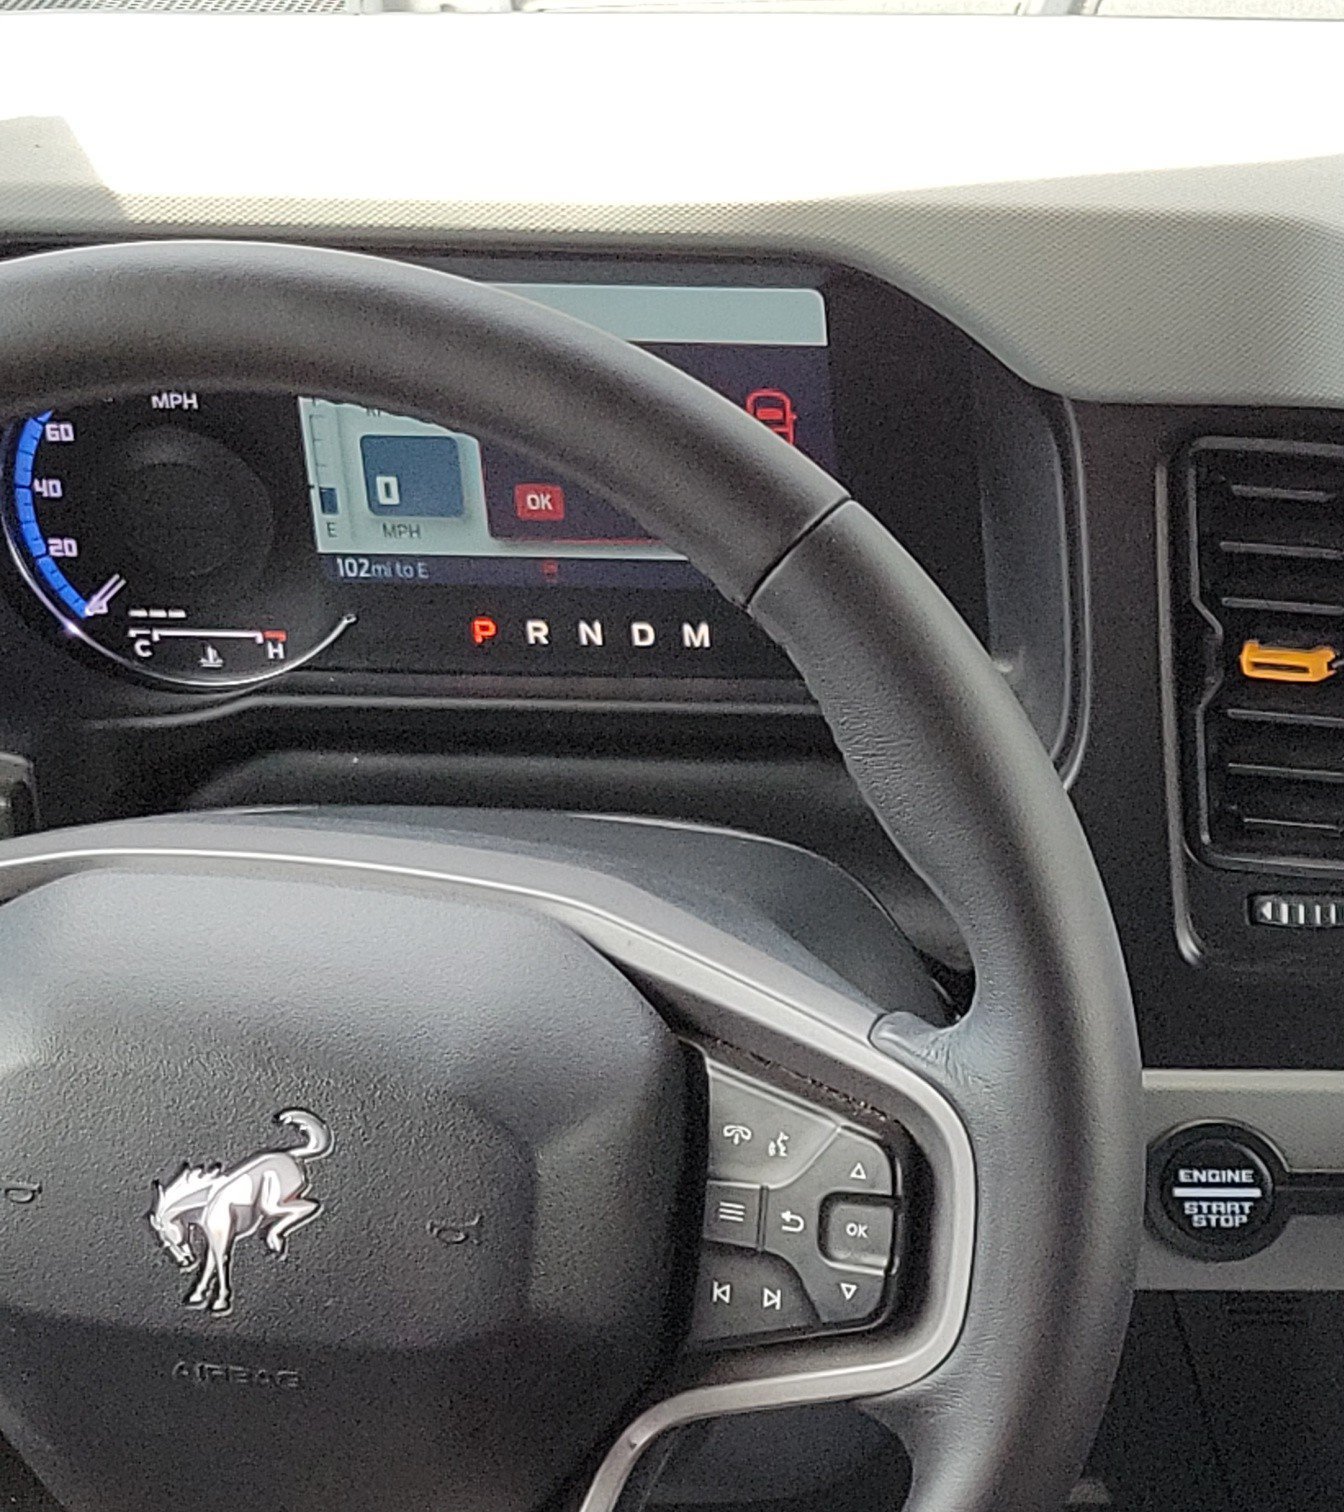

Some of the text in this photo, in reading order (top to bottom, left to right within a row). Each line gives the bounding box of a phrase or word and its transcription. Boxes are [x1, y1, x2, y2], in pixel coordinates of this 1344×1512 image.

[151, 393, 199, 410] MPH
[45, 423, 75, 442] 60
[33, 479, 63, 498] 40
[376, 476, 400, 505] 0
[526, 494, 553, 511] OK
[327, 522, 338, 538] E
[383, 523, 421, 539] MPH
[48, 538, 78, 557] 20
[473, 617, 711, 648] P R N D M
[135, 639, 152, 659] C
[268, 640, 285, 661] H
[1178, 1169, 1254, 1184] ENGINE
[1184, 1201, 1254, 1215] START
[1191, 1214, 1248, 1228] STOP
[846, 1222, 868, 1239] OK
